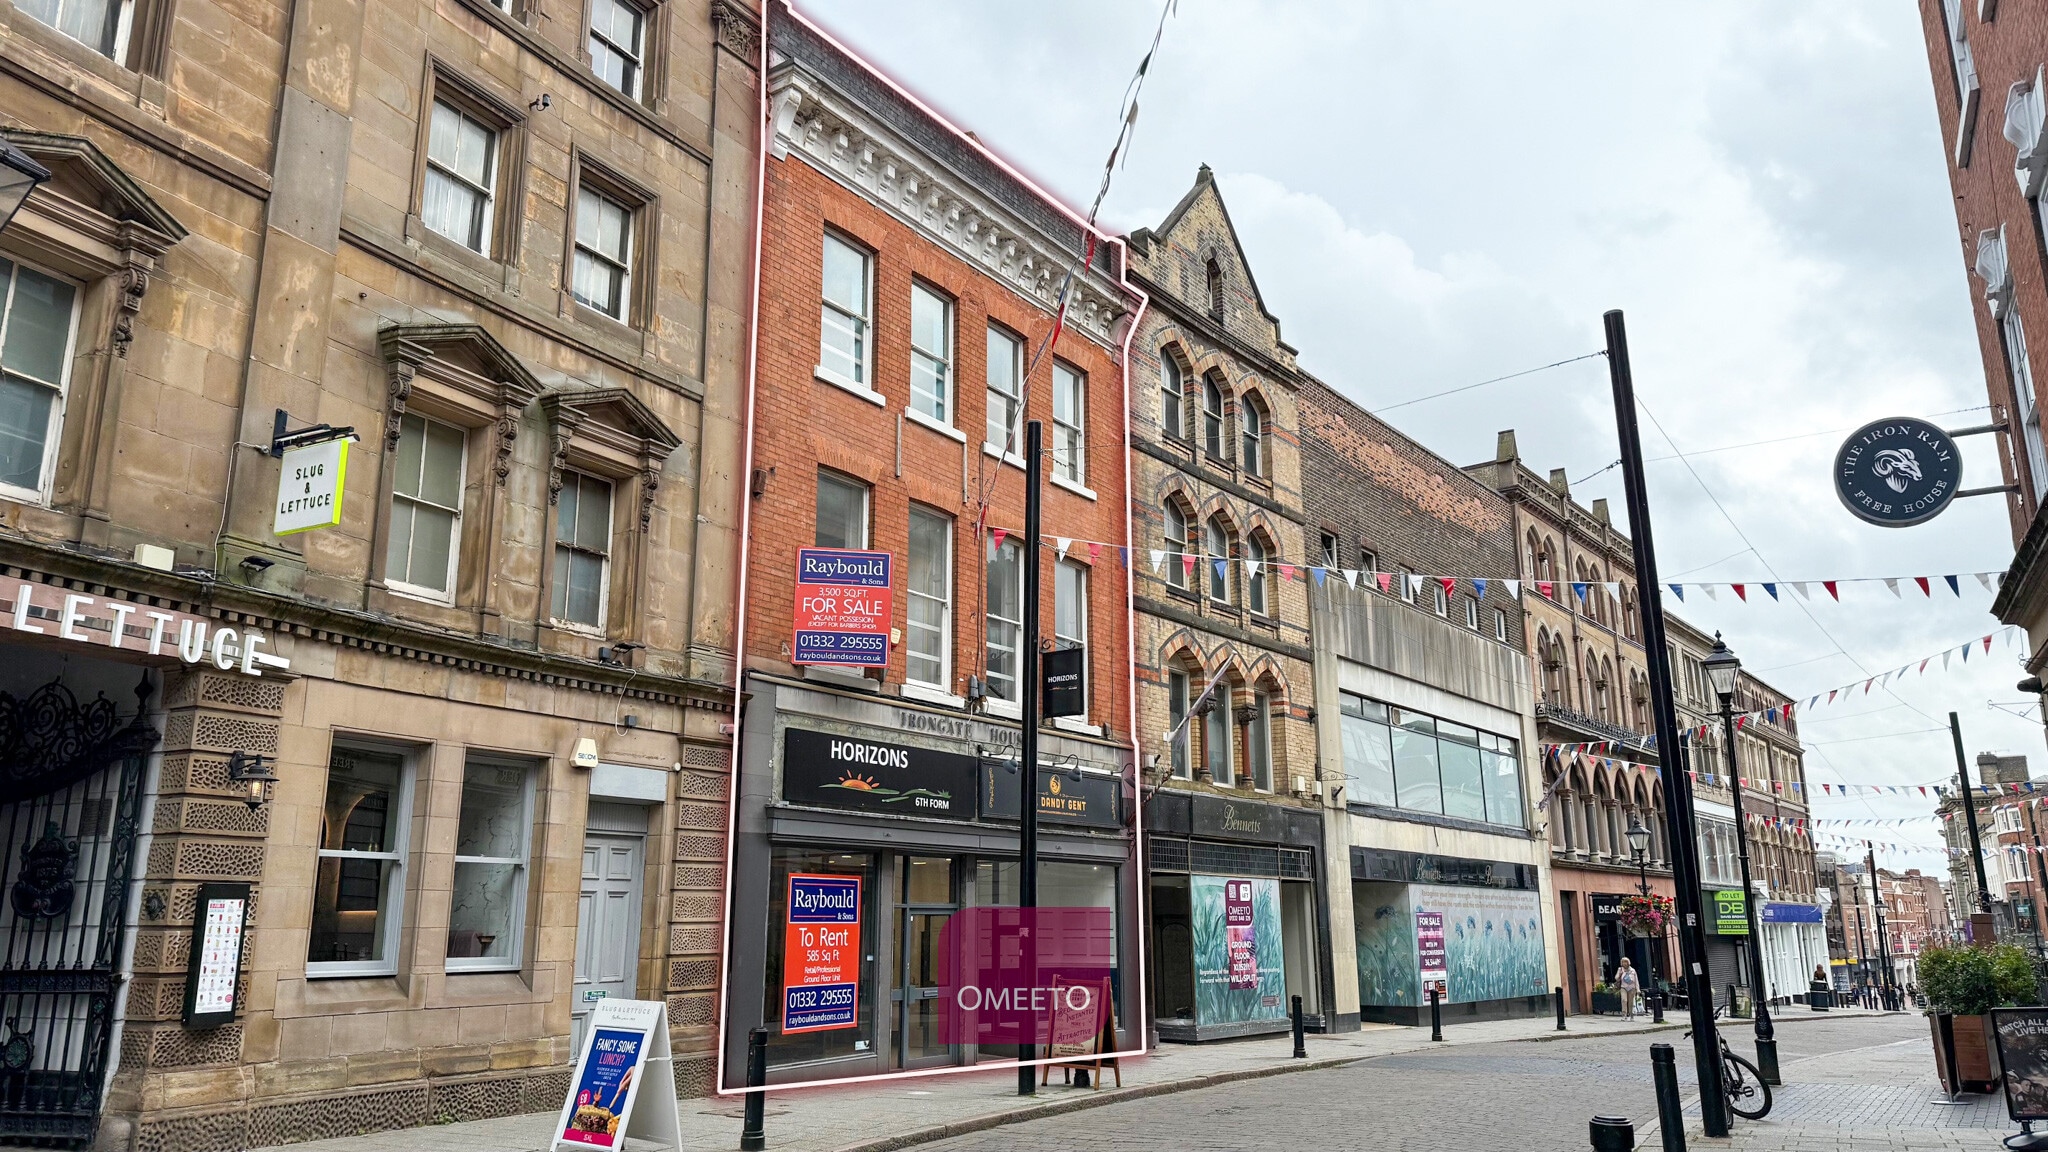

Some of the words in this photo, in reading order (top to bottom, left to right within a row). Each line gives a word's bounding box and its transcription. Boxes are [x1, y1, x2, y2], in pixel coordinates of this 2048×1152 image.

[1844, 444, 1864, 477] THE
[1863, 425, 1912, 445] IRON
[1917, 430, 1951, 463] RAM
[295, 463, 325, 481] SLUG
[304, 481, 311, 495] &
[280, 493, 332, 515] LETTUCE
[1854, 489, 1893, 514] FREE
[1903, 479, 1948, 514] HOUSE
[804, 558, 885, 577] Raybould
[868, 578, 884, 586] Sons
[818, 587, 841, 597] 3,500
[802, 597, 837, 614] FOR
[843, 599, 883, 617] SALE
[811, 614, 838, 622] VACANT
[13, 584, 267, 677] LETTUCE
[800, 634, 835, 648] 01332
[840, 636, 883, 650] 295555
[800, 653, 881, 662] raybouldandsons.co.uk
[1047, 674, 1078, 683] HORIZONS
[900, 711, 973, 738] IRONGATE
[990, 728, 1022, 746] HOUS
[830, 740, 909, 769] HORIZONS
[915, 797, 929, 808] 6TH
[929, 799, 950, 810] FORM
[1041, 796, 1066, 809] DANDY
[1068, 799, 1087, 811] GENT
[1221, 804, 1261, 833] Bennetts
[794, 888, 855, 913] Raybould
[1228, 905, 1251, 916] OMEETO
[1419, 917, 1429, 926] FOR
[1429, 917, 1441, 926] SALE
[798, 927, 814, 948] To
[819, 927, 849, 947] Rent
[1231, 941, 1252, 949] GROUND
[806, 949, 820, 962] 585
[821, 949, 831, 964] Sq
[833, 949, 840, 961] Ft
[1233, 952, 1250, 960] FLOOR
[804, 975, 820, 983] Ground
[820, 974, 832, 983] Floor
[832, 974, 841, 982] Unit
[1230, 974, 1242, 983] WILL
[1242, 973, 1256, 982] SPLIT
[789, 990, 817, 1009] 01332
[820, 988, 852, 1006] 295555
[788, 1011, 852, 1027] raybouldandsons.co.uk
[1998, 1019, 2027, 1036] WATCH
[2028, 1018, 2045, 1026] ALL
[2014, 1026, 2037, 1038] LIVE
[596, 1037, 619, 1052] FANCY
[616, 1040, 638, 1054] SOME
[598, 1052, 626, 1067] LUNCH?
